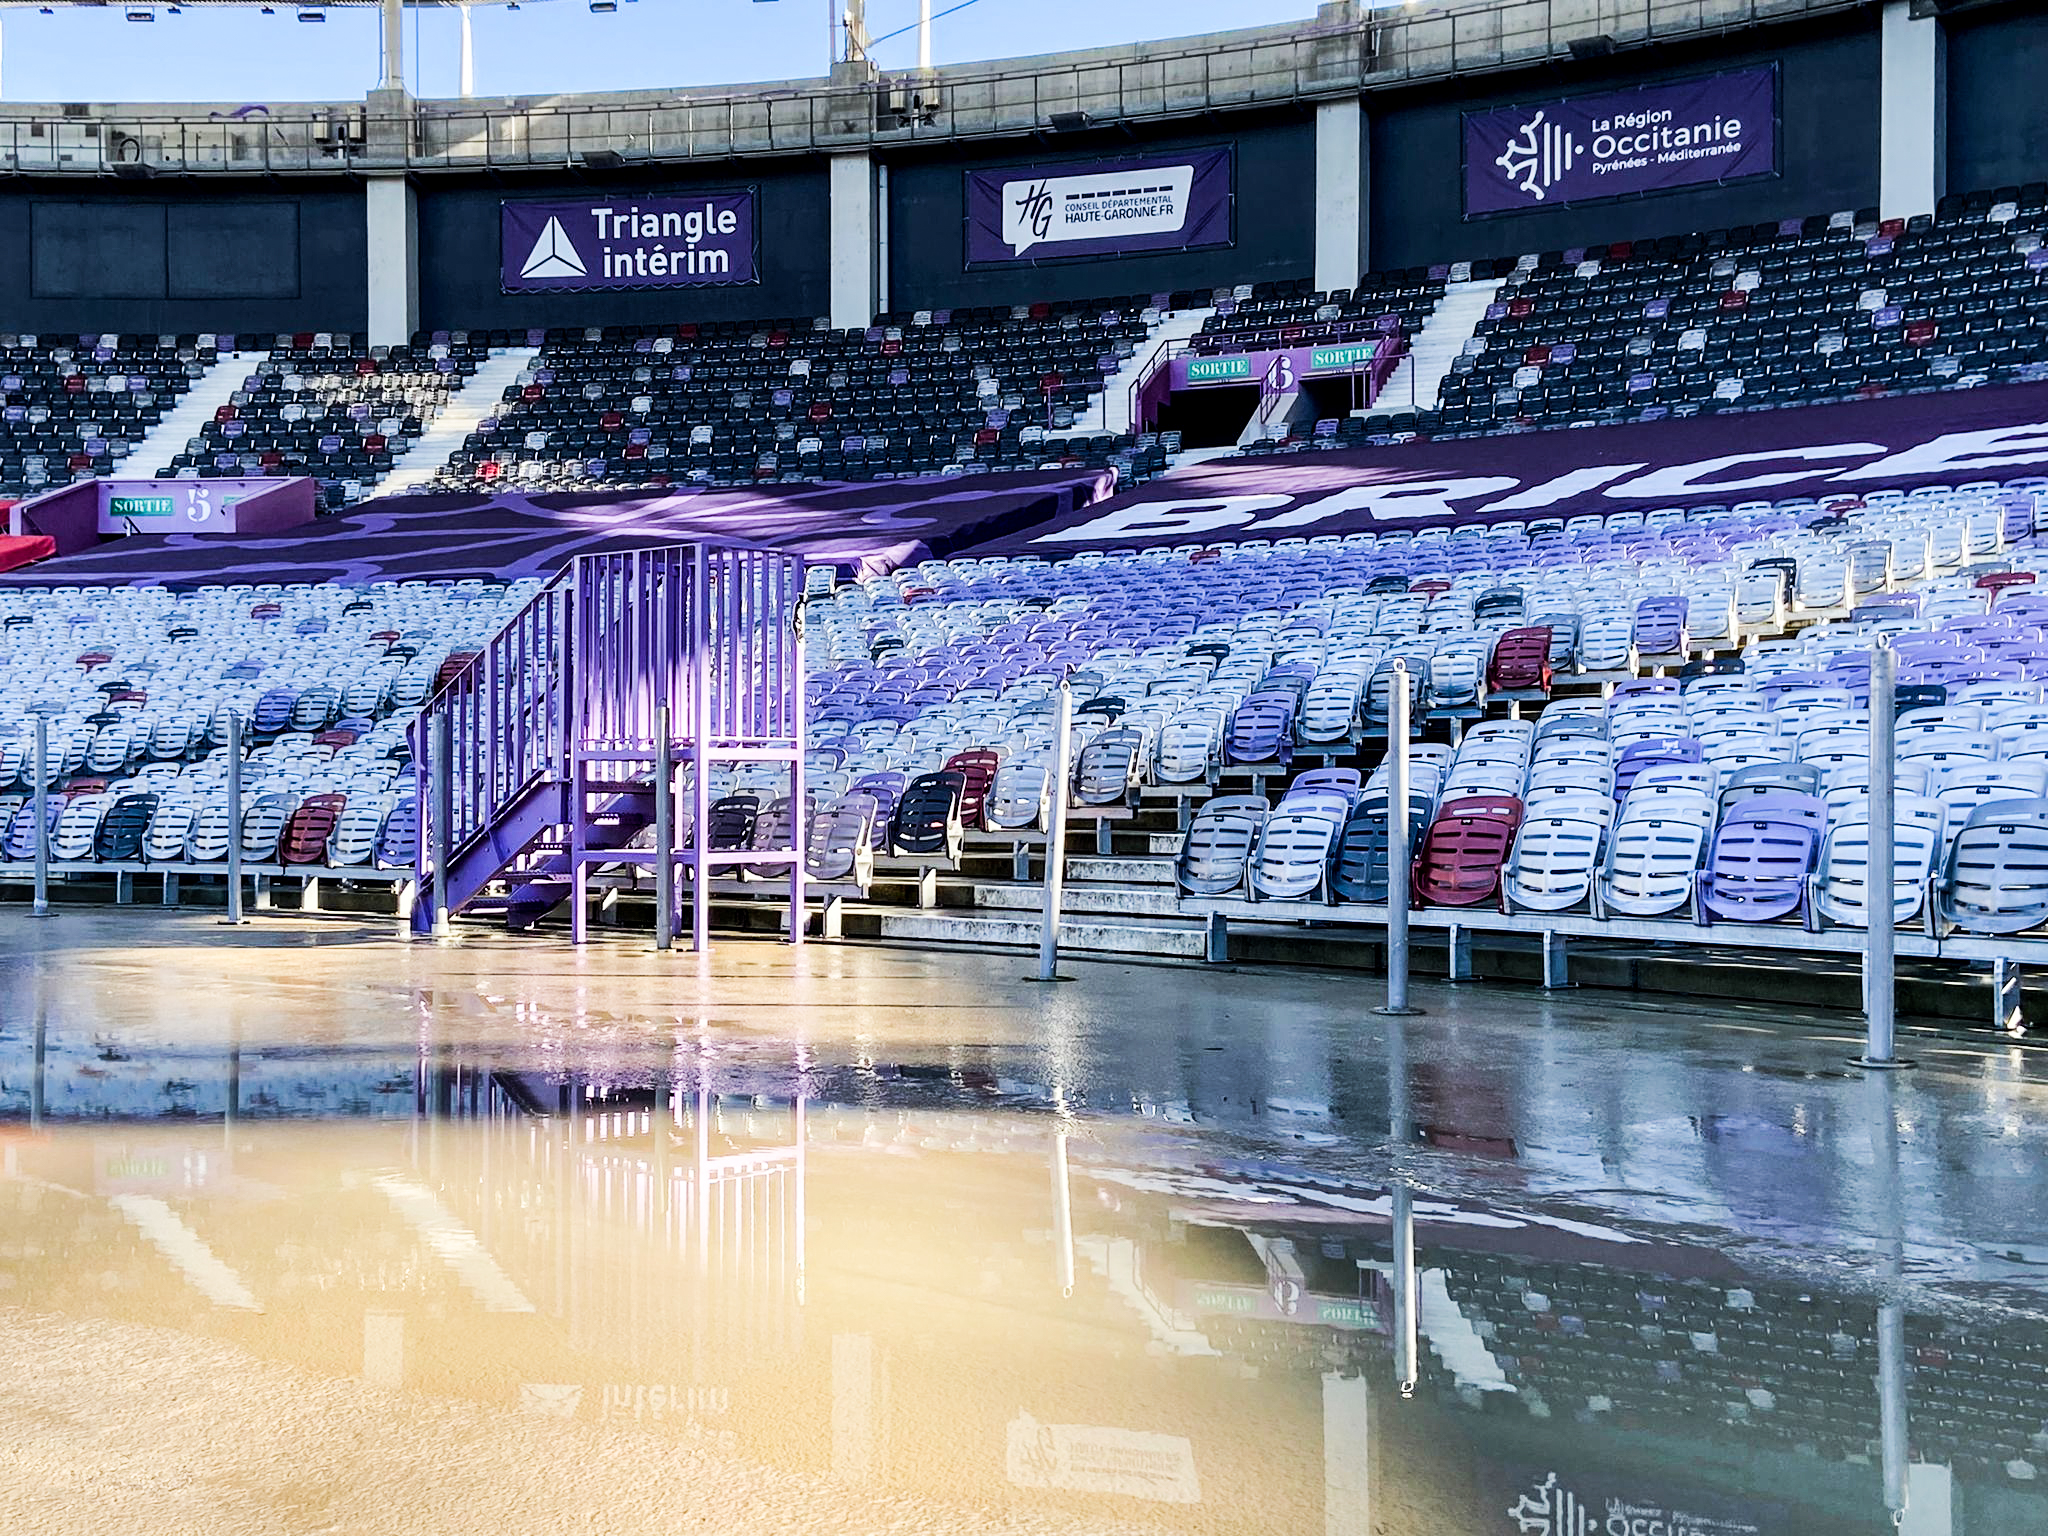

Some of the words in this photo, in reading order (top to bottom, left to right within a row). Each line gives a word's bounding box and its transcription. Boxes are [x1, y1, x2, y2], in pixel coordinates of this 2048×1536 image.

[1592, 119, 1610, 133] La
[1614, 109, 1672, 130] Région
[1592, 115, 1742, 158] Occitanie
[1592, 155, 1648, 175] Pyrénées
[1657, 141, 1742, 164] Méditerranée
[1015, 178, 1053, 239] HG
[1064, 202, 1100, 212] CONSEIL
[1101, 195, 1173, 209] DÉPARTEMENTAL
[1065, 205, 1174, 224] HAUTE-GARONNE.FR
[591, 203, 737, 242] Triangle
[603, 243, 729, 278] intérim
[1191, 359, 1247, 377] SORTIE
[1267, 356, 1294, 390] 6
[1315, 347, 1373, 366] SORTIE
[114, 497, 172, 514] SORTIE
[186, 488, 211, 522] 5
